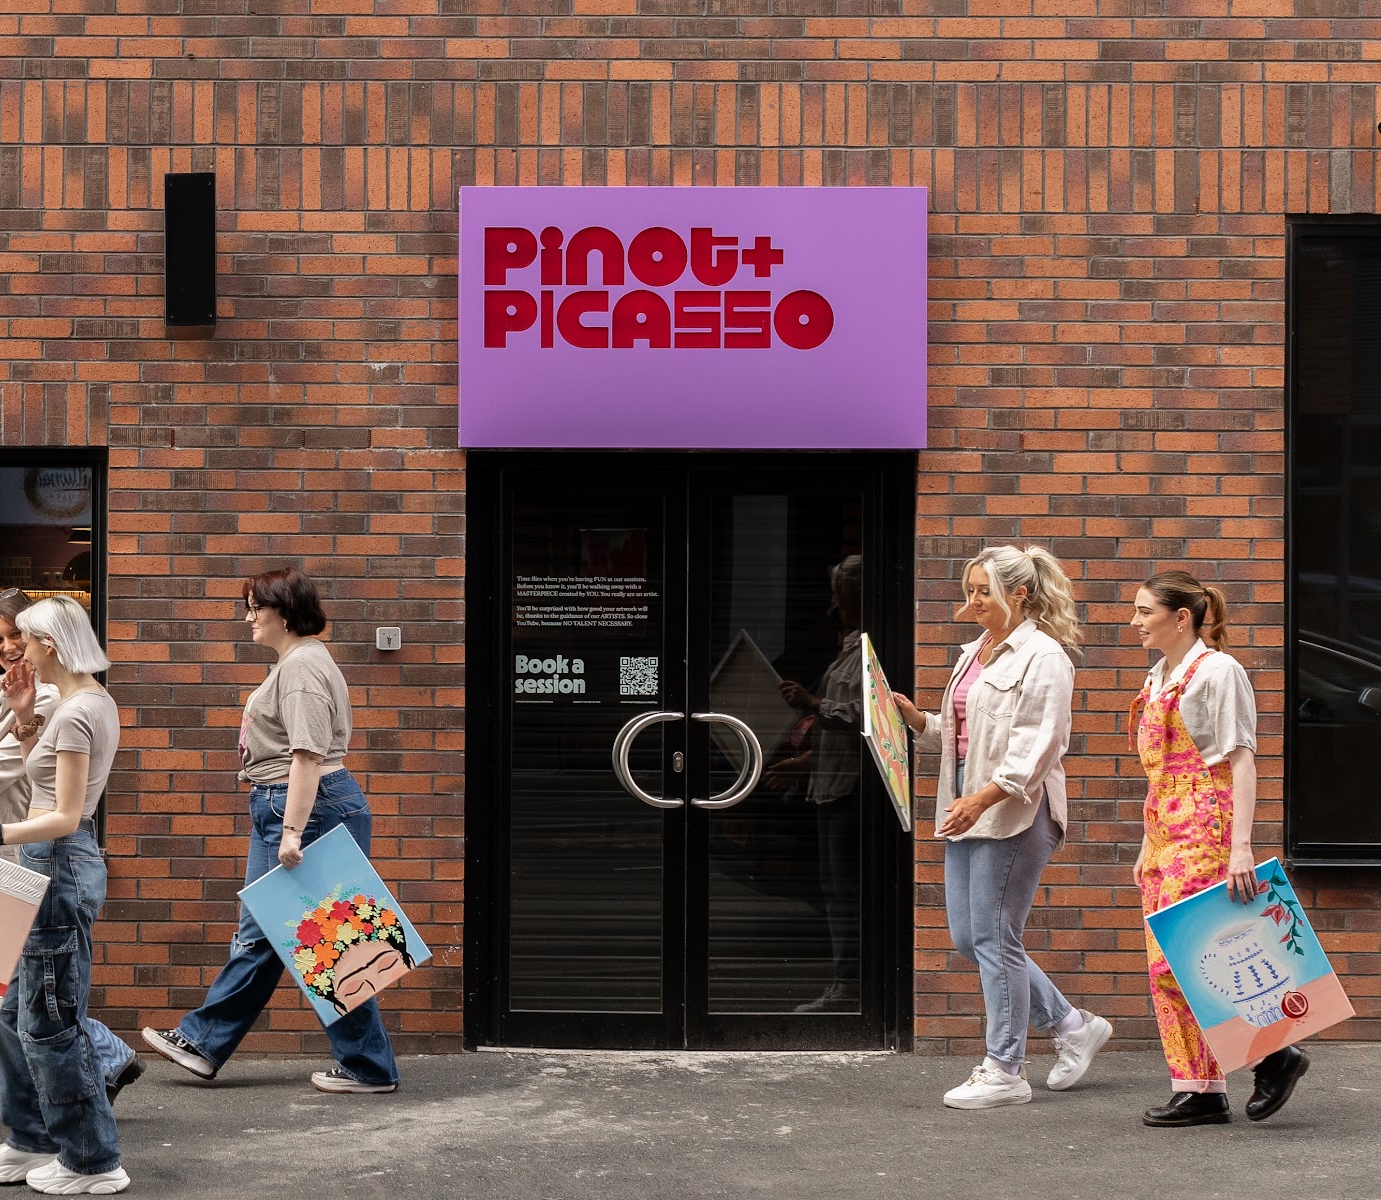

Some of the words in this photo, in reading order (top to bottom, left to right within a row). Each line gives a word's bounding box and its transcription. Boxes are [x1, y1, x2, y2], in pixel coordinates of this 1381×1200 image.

[484, 289, 835, 351] PICASSO
[515, 655, 569, 674] Book
[571, 658, 585, 674] a
[515, 673, 586, 694] session
